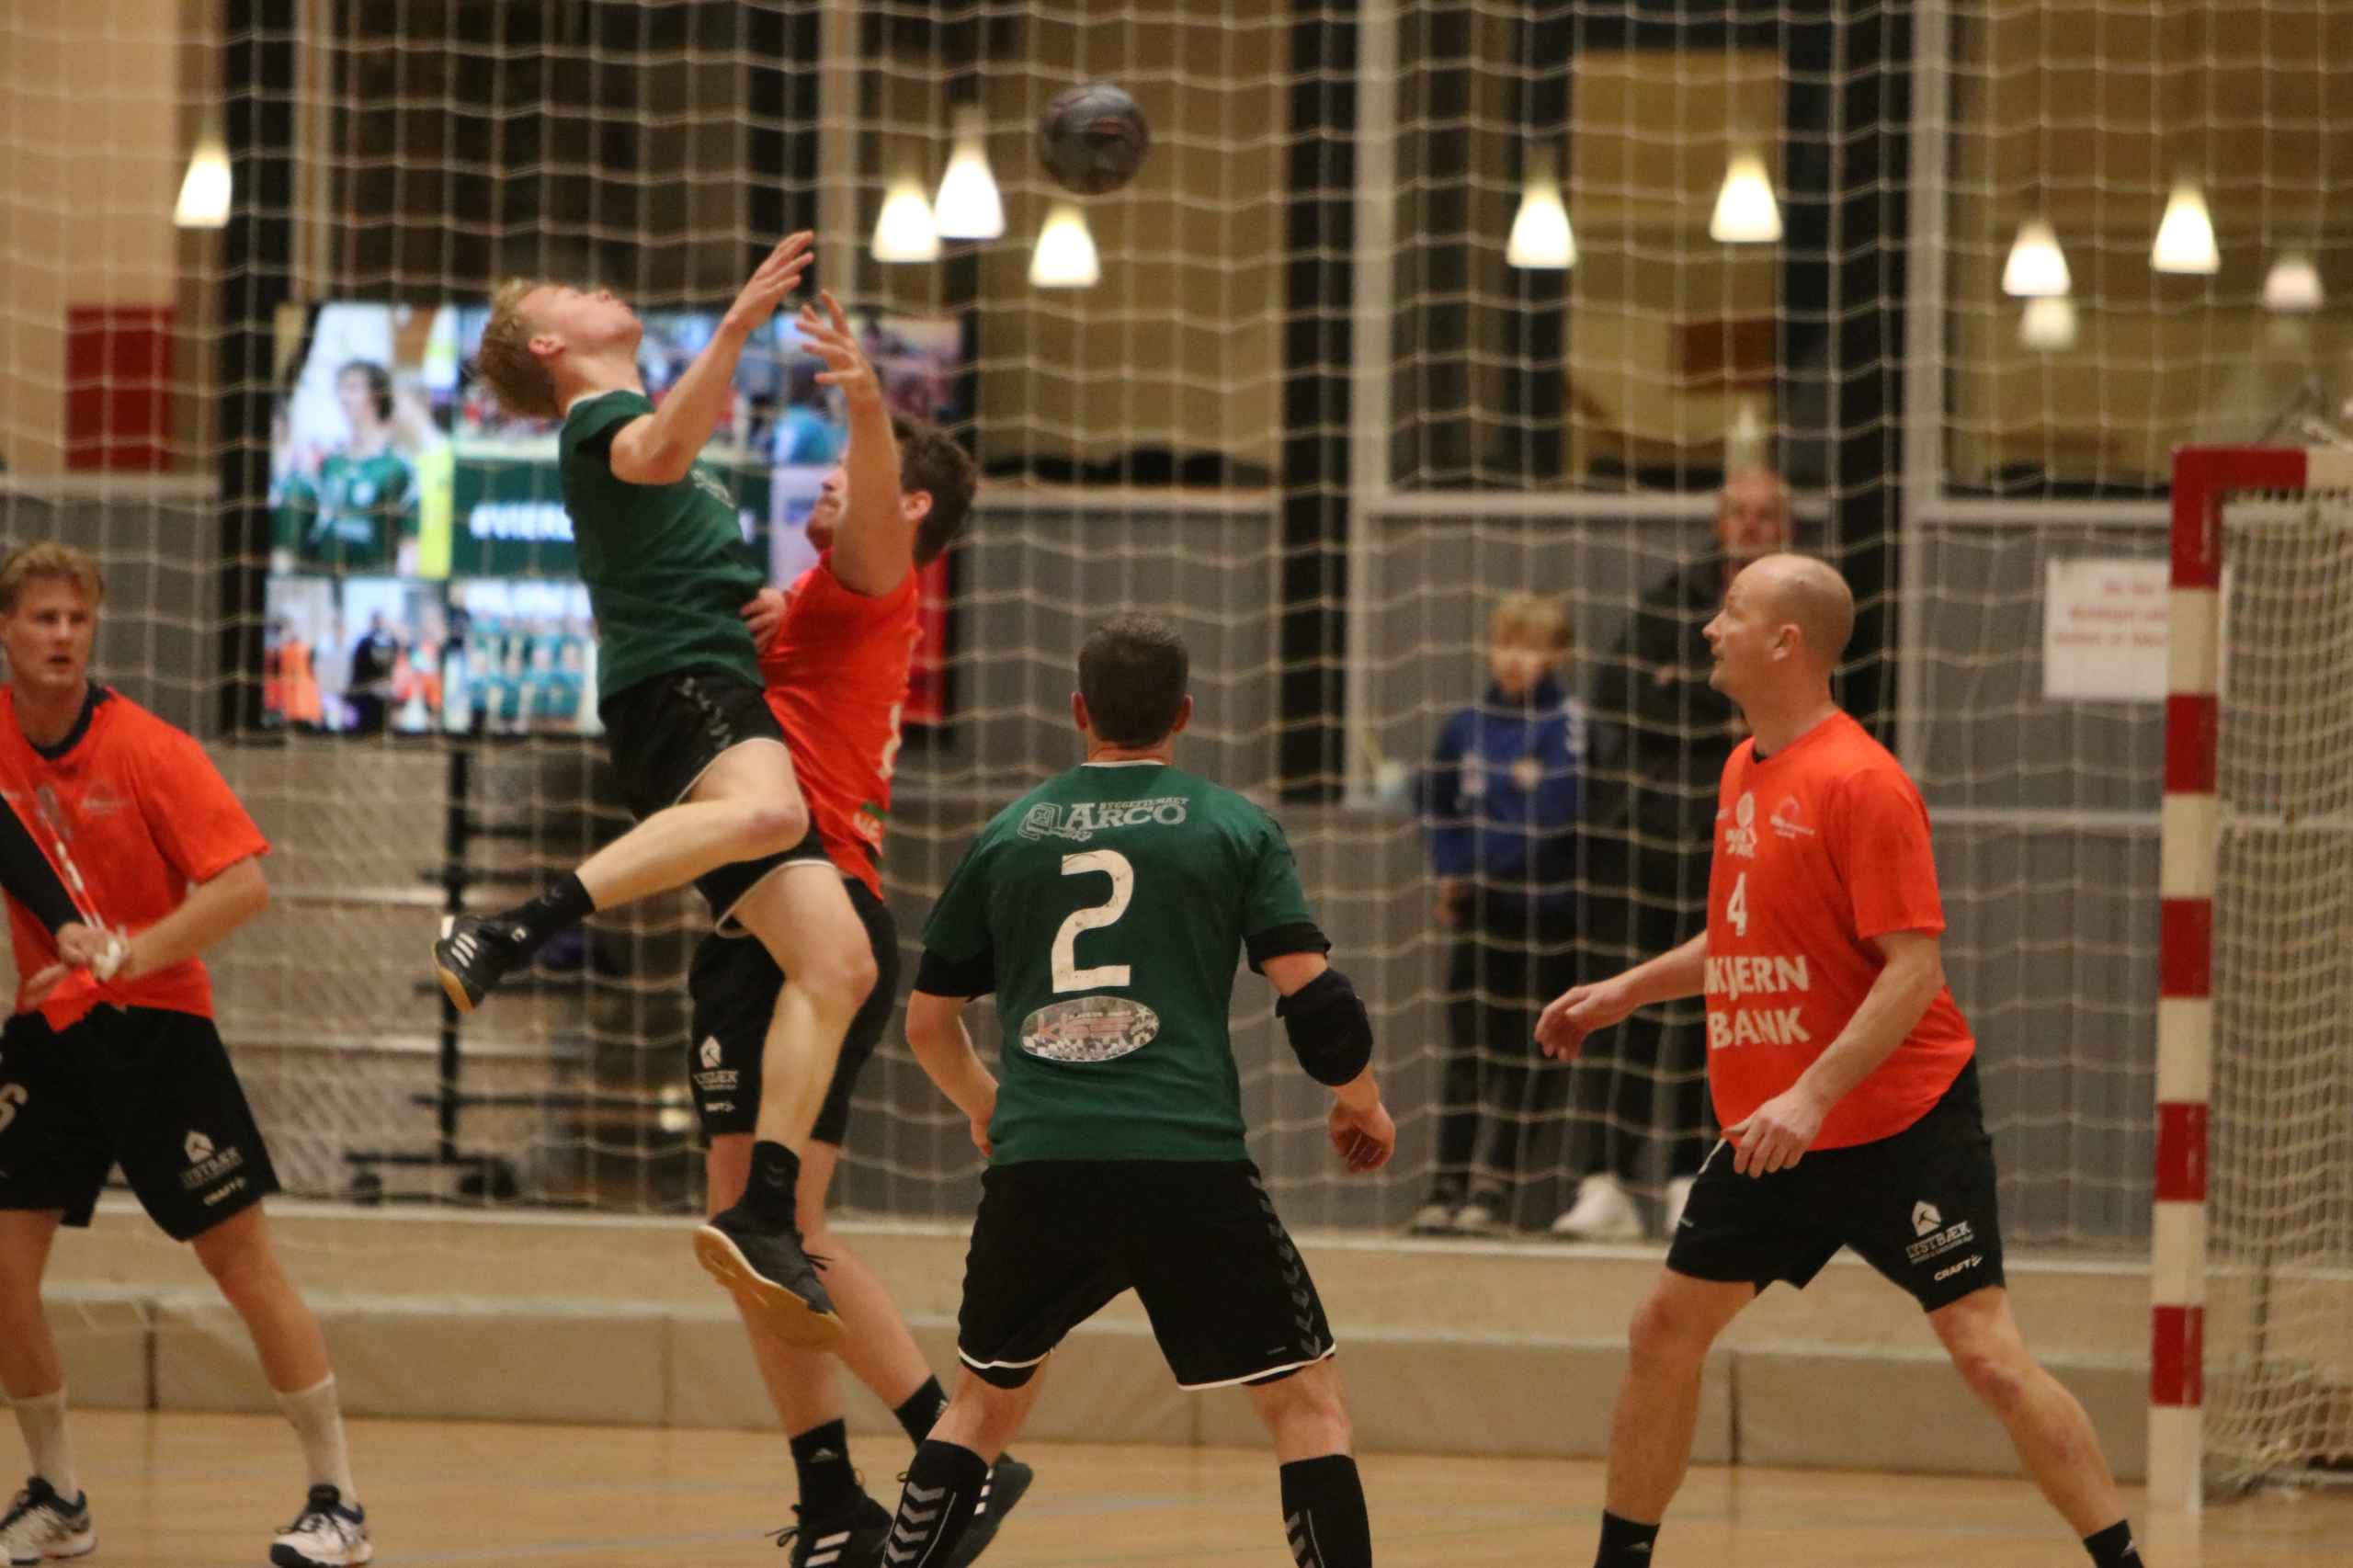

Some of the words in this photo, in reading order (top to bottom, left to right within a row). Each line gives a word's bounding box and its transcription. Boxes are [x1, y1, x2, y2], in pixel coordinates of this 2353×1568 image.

[1064, 802, 1187, 830] ARCO
[1051, 849, 1134, 994] 2
[1727, 871, 1748, 937] 4
[1704, 955, 1809, 1000] KJERN
[1708, 1007, 1811, 1050] BANK
